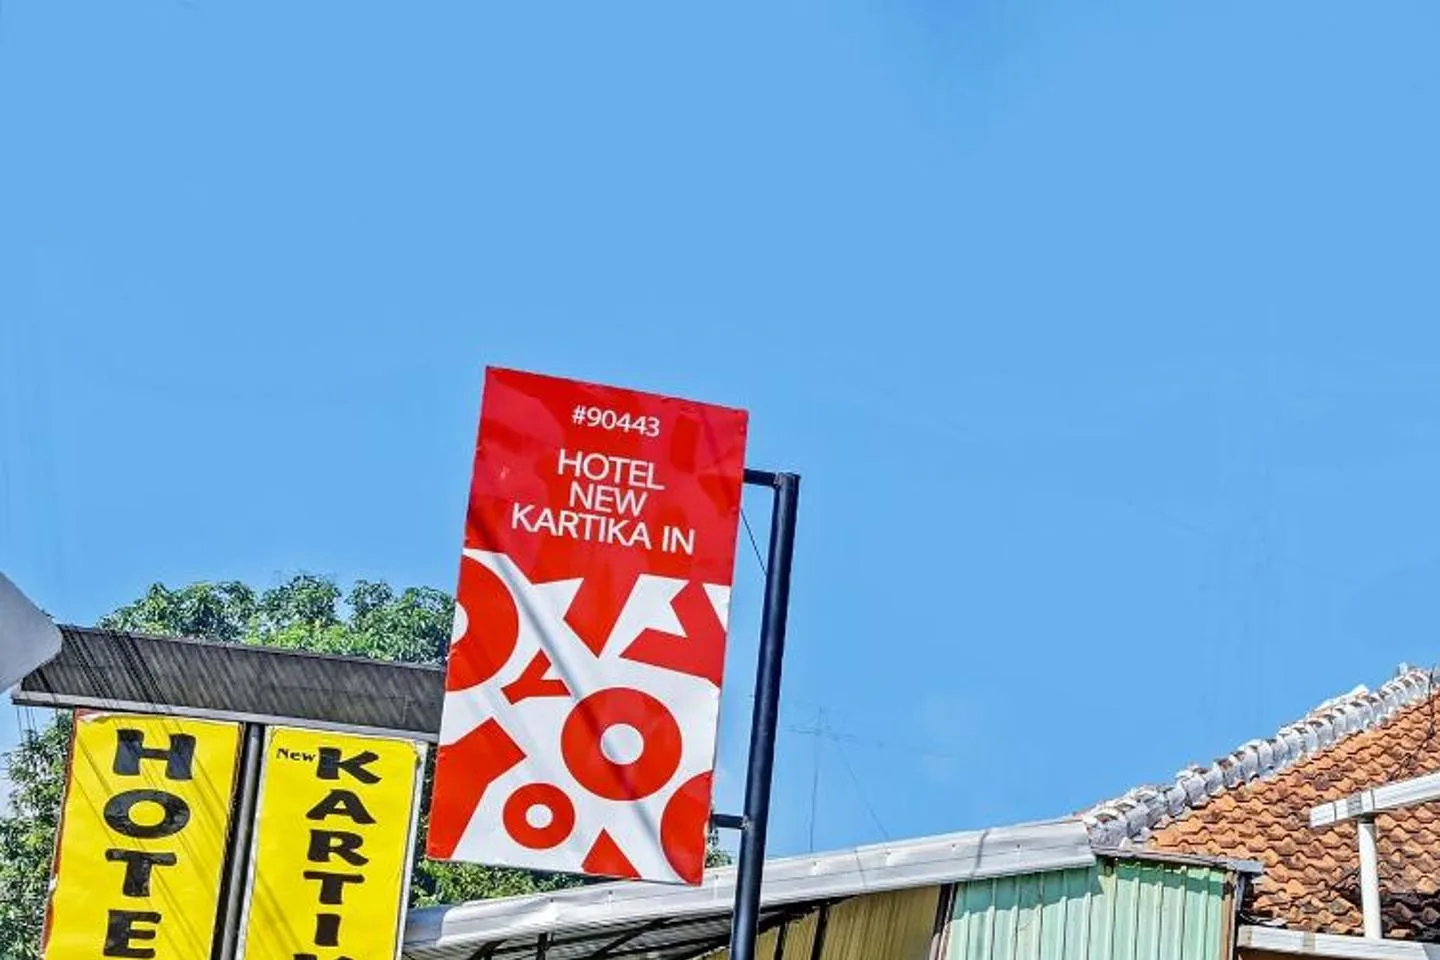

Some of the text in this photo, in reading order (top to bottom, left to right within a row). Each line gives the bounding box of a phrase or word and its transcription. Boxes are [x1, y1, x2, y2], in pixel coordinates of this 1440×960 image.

[571, 404, 661, 437] #90443
[557, 448, 665, 490] HOTEL
[569, 481, 648, 517] NEW
[511, 502, 696, 555] KARTIKA IN
[276, 747, 315, 762] New
